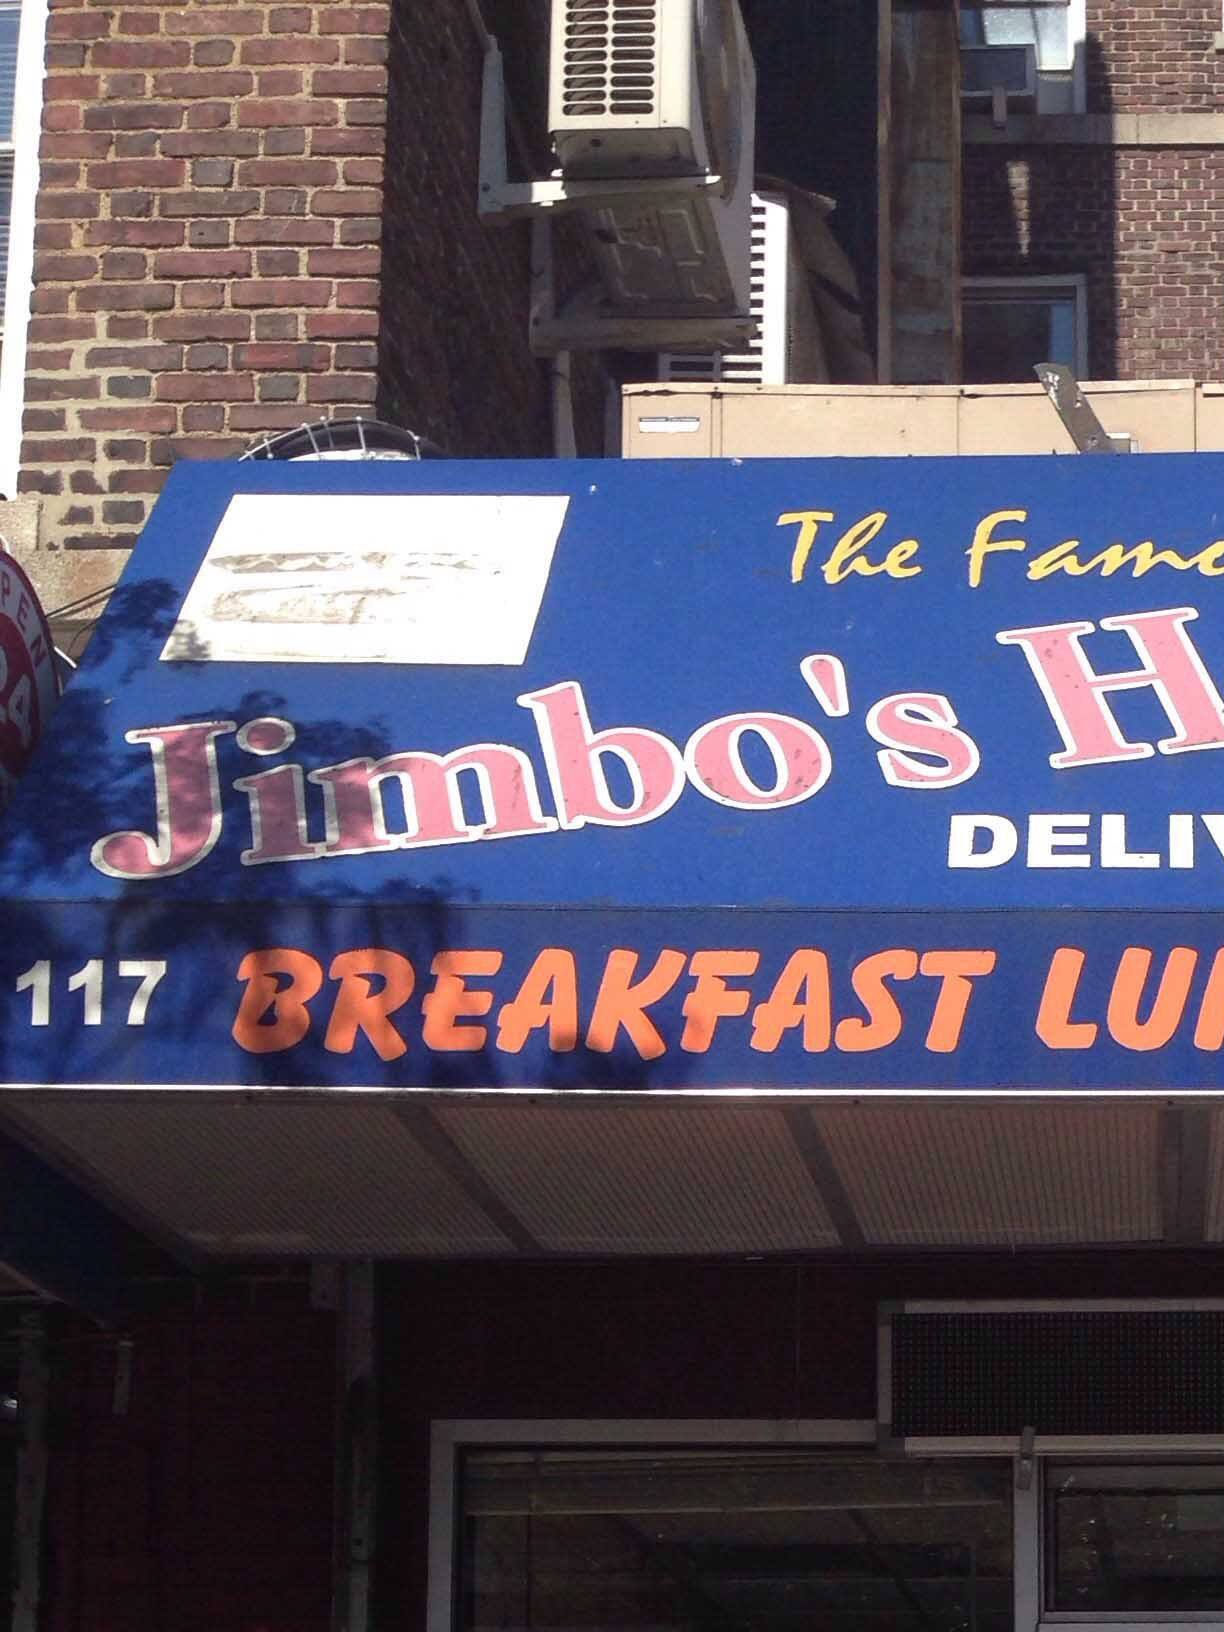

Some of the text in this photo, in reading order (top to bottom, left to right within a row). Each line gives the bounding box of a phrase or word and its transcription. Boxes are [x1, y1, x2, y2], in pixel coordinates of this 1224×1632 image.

[777, 511, 923, 586] The
[89, 654, 980, 881] Jimbo's
[15, 958, 166, 1026] 117
[231, 948, 995, 1061] BREAKFAST
